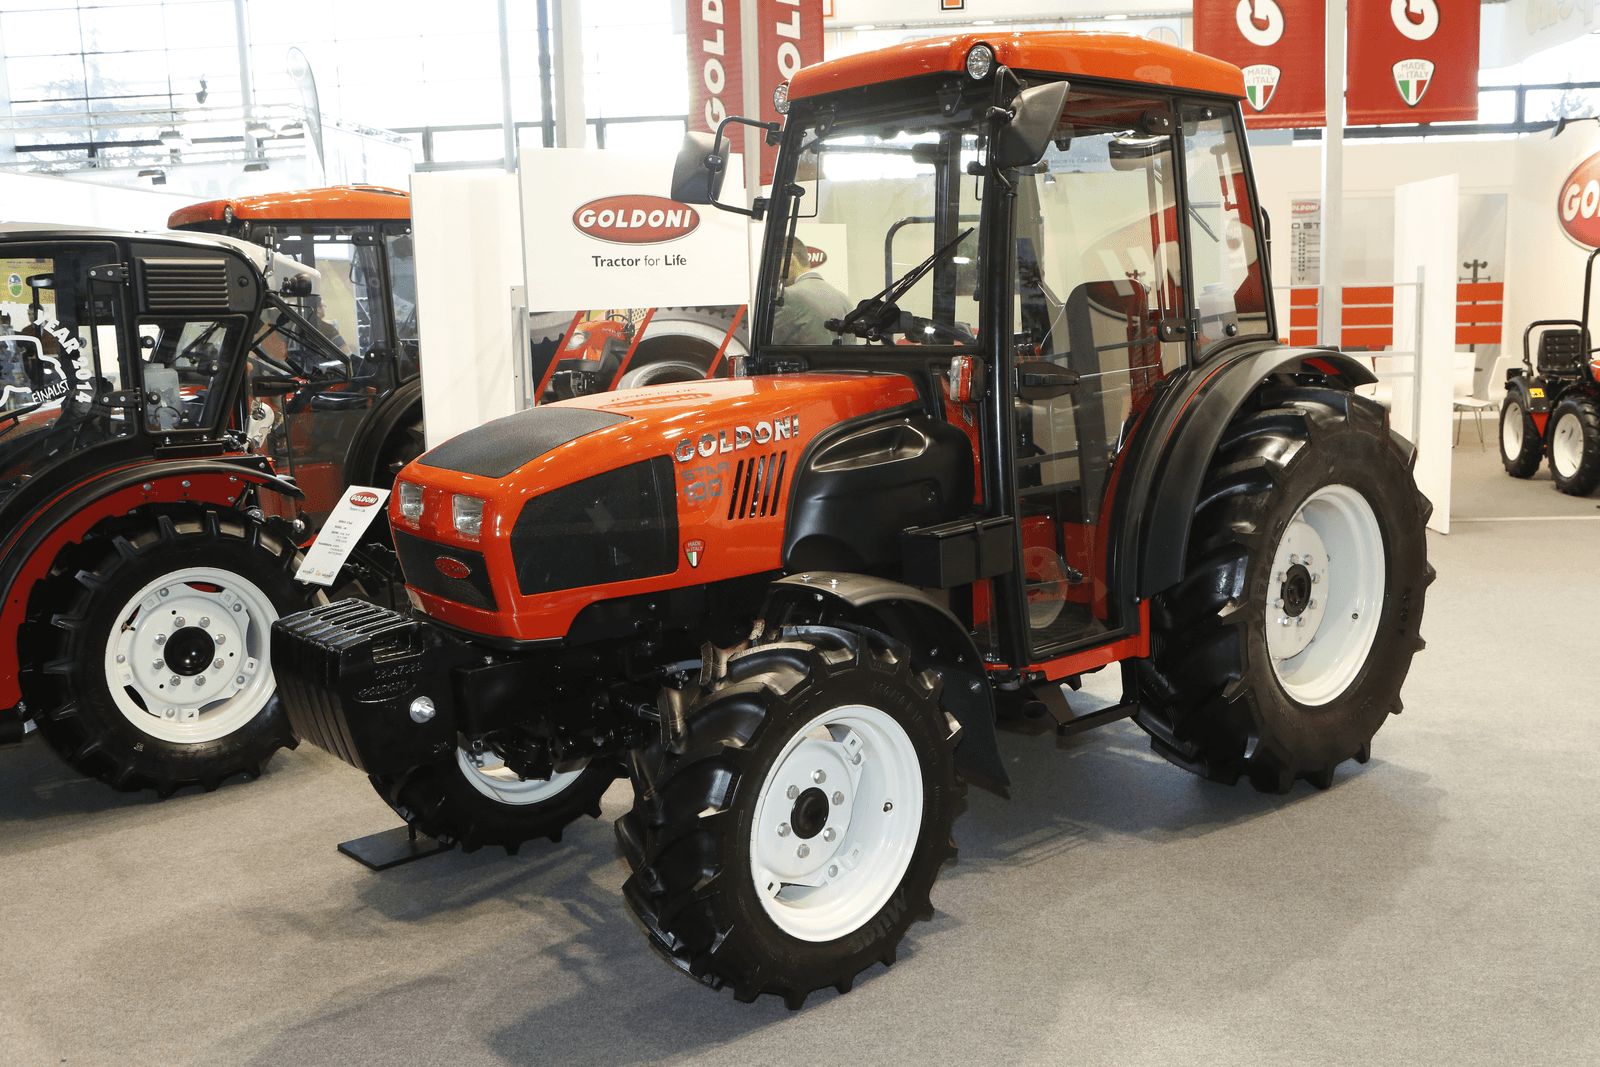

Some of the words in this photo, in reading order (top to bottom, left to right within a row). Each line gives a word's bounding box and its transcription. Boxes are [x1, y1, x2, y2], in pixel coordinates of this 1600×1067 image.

[1236, 0, 1284, 46] G
[1391, 0, 1439, 41] G
[1247, 67, 1272, 76] MADE
[1401, 62, 1426, 71] MADE
[1406, 71, 1429, 79] ITALY
[1252, 76, 1275, 84] ITALY
[578, 209, 692, 228] GOLDONI
[592, 255, 641, 267] Tractor
[644, 255, 660, 267] for
[664, 254, 687, 266] Life
[34, 309, 80, 354] YEAR
[71, 356, 93, 403] 2014
[31, 379, 70, 405] FINALIST
[675, 414, 799, 463] GOLDONI
[681, 461, 731, 482] STAR
[351, 494, 378, 504] GOLDONI
[683, 478, 724, 504] 100
